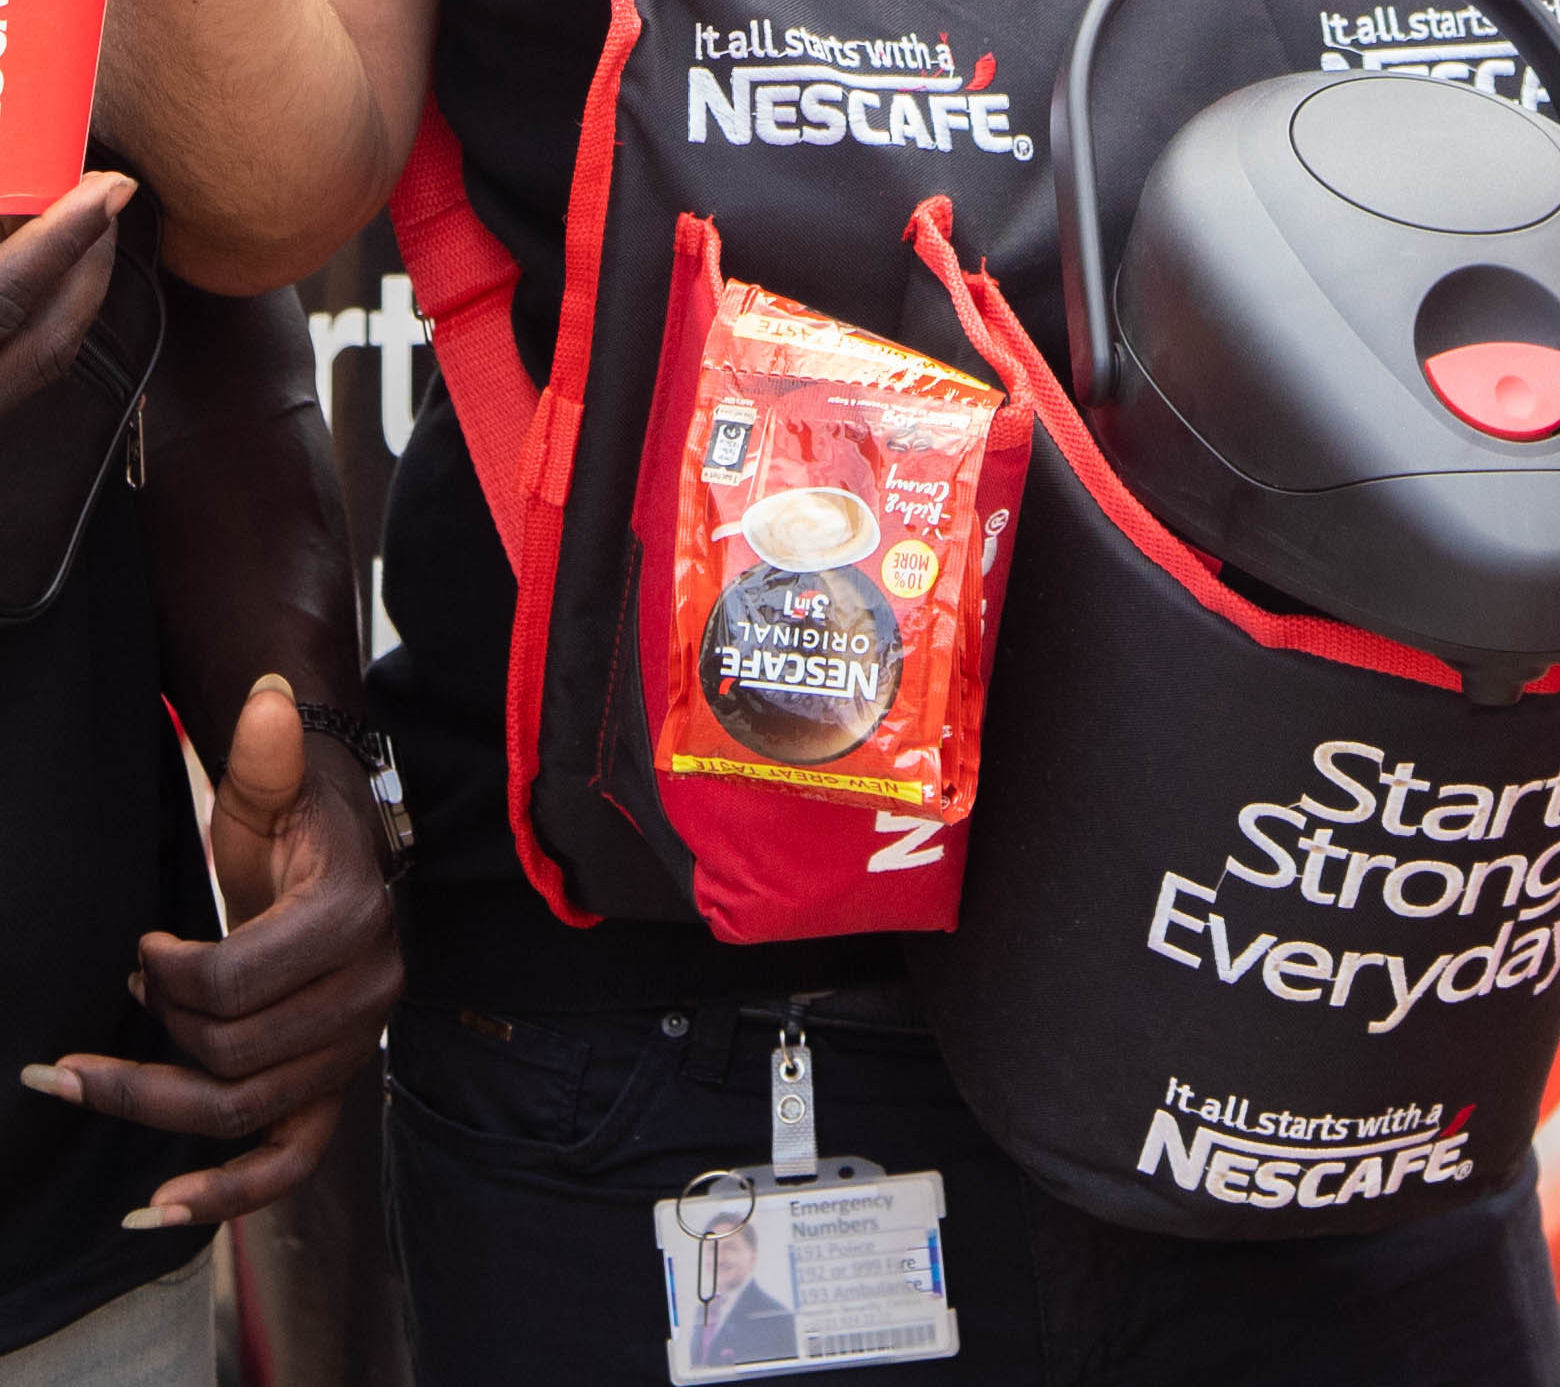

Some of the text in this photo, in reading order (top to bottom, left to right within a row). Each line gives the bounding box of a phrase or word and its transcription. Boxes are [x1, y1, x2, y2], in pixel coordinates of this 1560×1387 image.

[1320, 11, 1351, 45] It
[1356, 6, 1404, 44] all
[695, 19, 955, 72] It all starts with a
[886, 463, 950, 502] Creamy
[893, 553, 930, 570] MORE
[893, 570, 924, 590] 10%
[738, 622, 870, 654] ORIGINAL
[696, 761, 900, 796] NEW GREAT TASTE
[1165, 1077, 1445, 1142] It all starts with a
[1137, 1103, 1477, 1209] NESCAFÉ
[790, 1194, 894, 1217] Emergency
[793, 1217, 880, 1239] Numbers
[797, 1241, 876, 1260] 191 Police
[799, 1265, 827, 1283] 192
[832, 1266, 847, 1280] or
[854, 1260, 881, 1277] 999
[801, 1278, 923, 1304] 193 Ambulance
